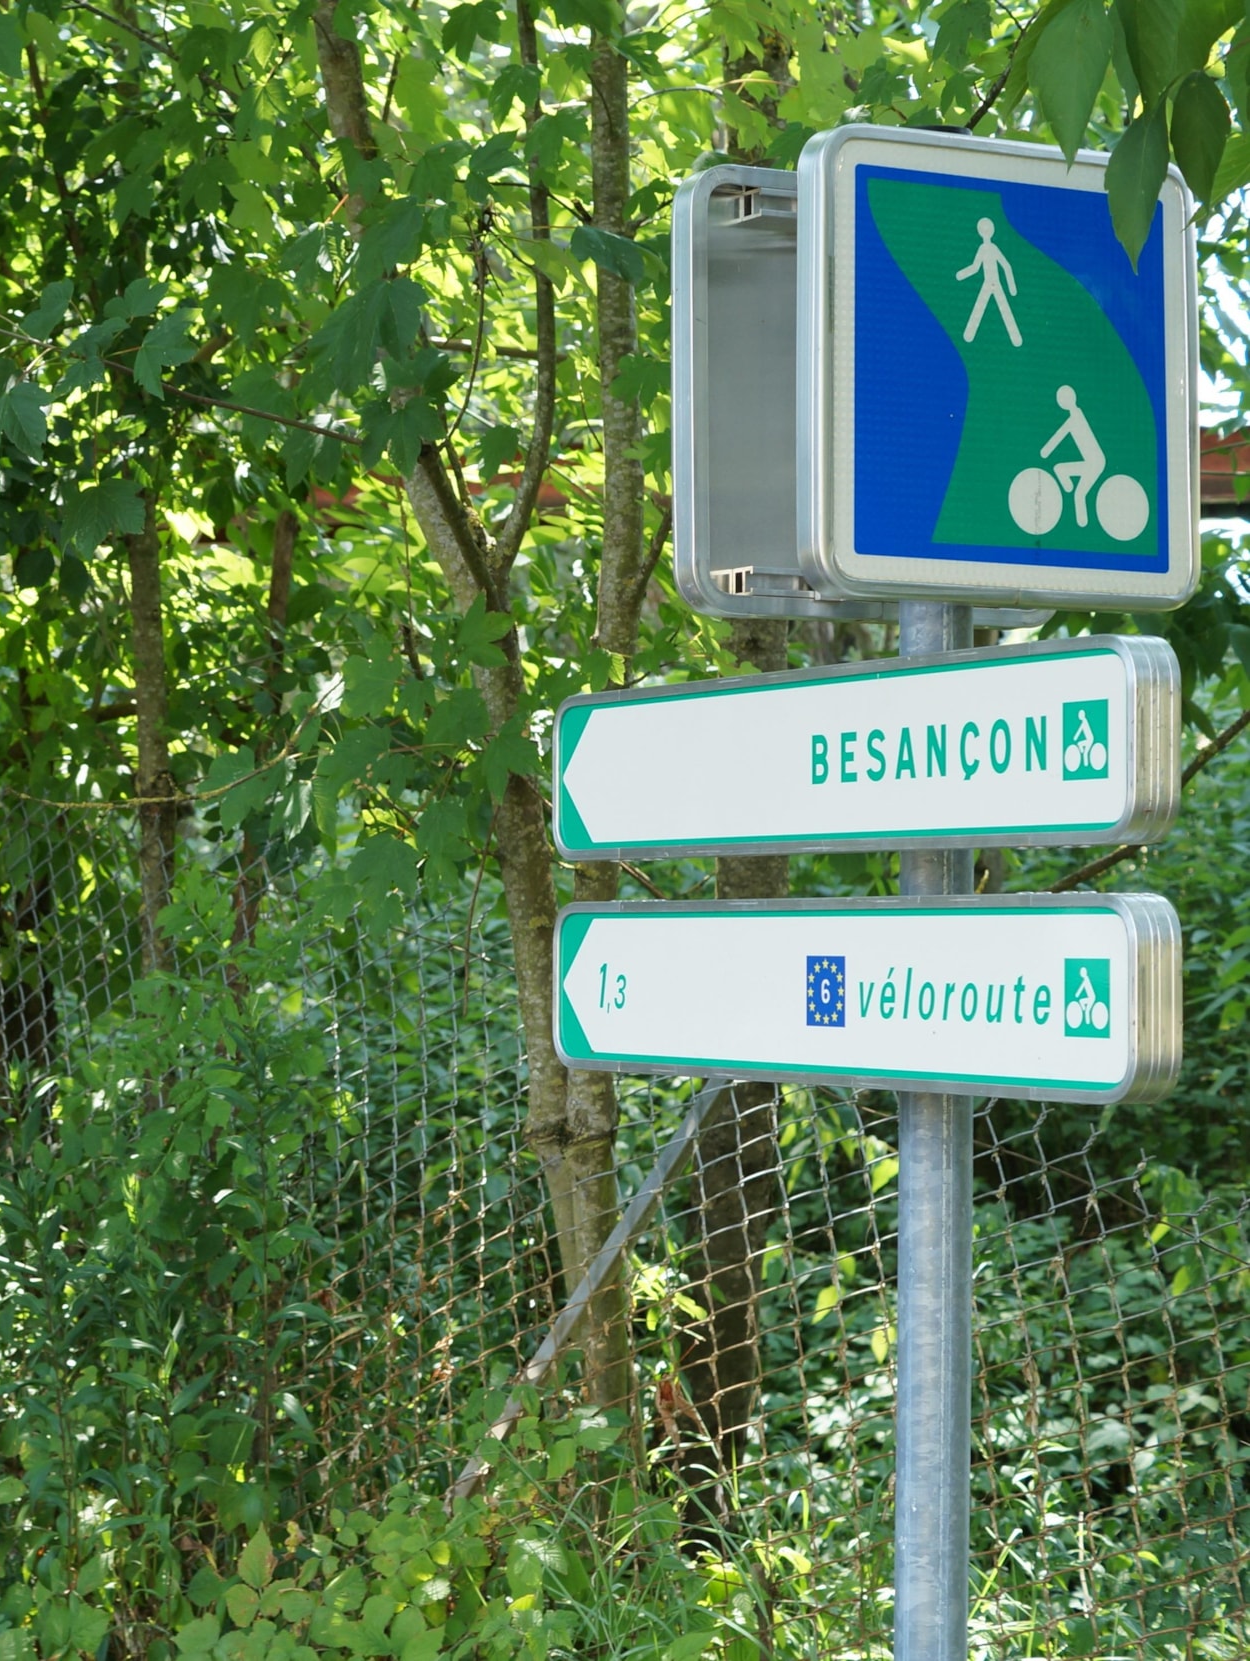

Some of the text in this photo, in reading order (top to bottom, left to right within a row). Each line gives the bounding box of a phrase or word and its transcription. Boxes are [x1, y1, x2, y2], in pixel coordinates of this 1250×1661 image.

[811, 715, 1047, 785] BESANÇON
[599, 962, 627, 1014] 1,3
[820, 966, 1052, 1026] 6 véloroute
